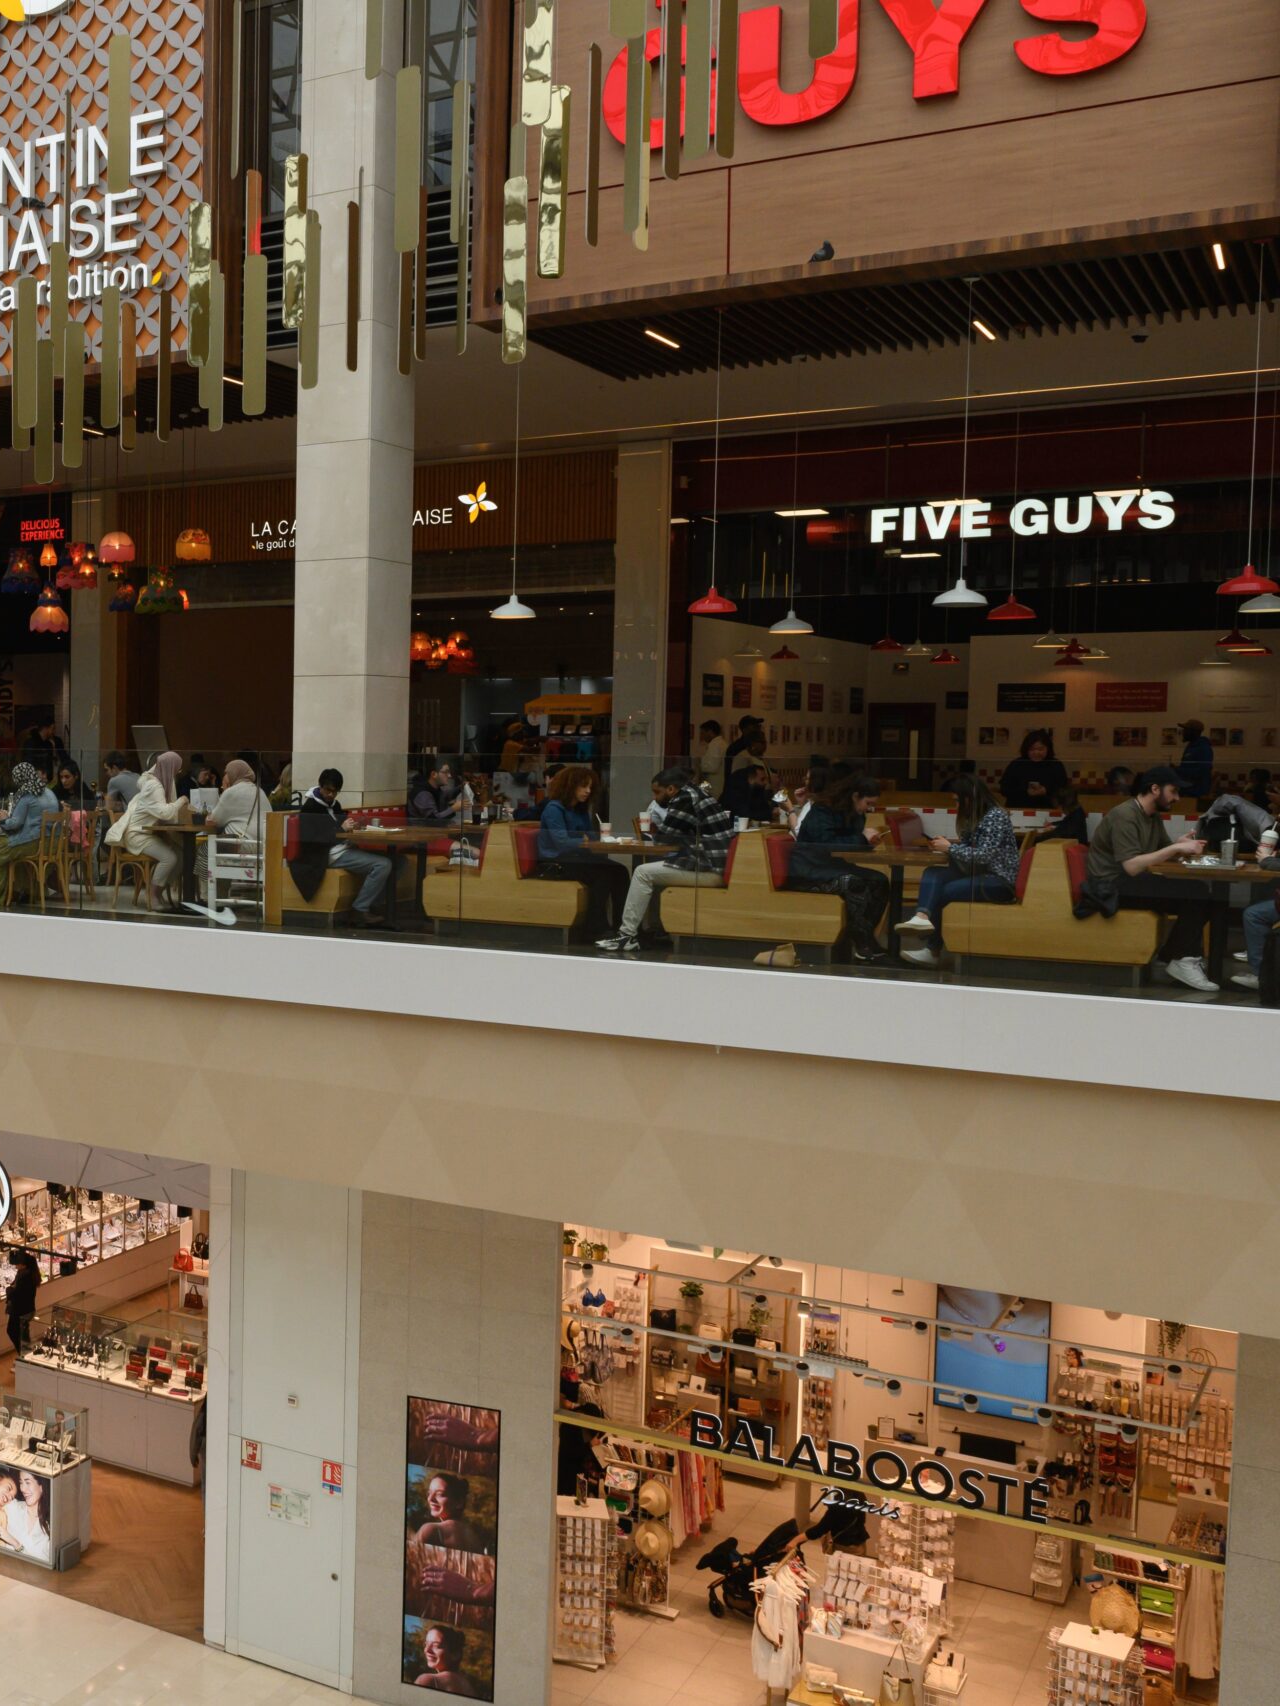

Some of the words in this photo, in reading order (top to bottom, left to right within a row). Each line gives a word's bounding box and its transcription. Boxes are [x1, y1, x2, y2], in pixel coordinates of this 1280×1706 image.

[20, 518, 60, 531] DELICIOUS
[870, 502, 992, 544] FIVE
[1009, 490, 1176, 537] GUYS
[20, 528, 65, 542] EXPERIENCE
[251, 520, 273, 537] LA
[255, 540, 265, 550] le
[689, 1409, 1050, 1525] BALABOOSTÉ
